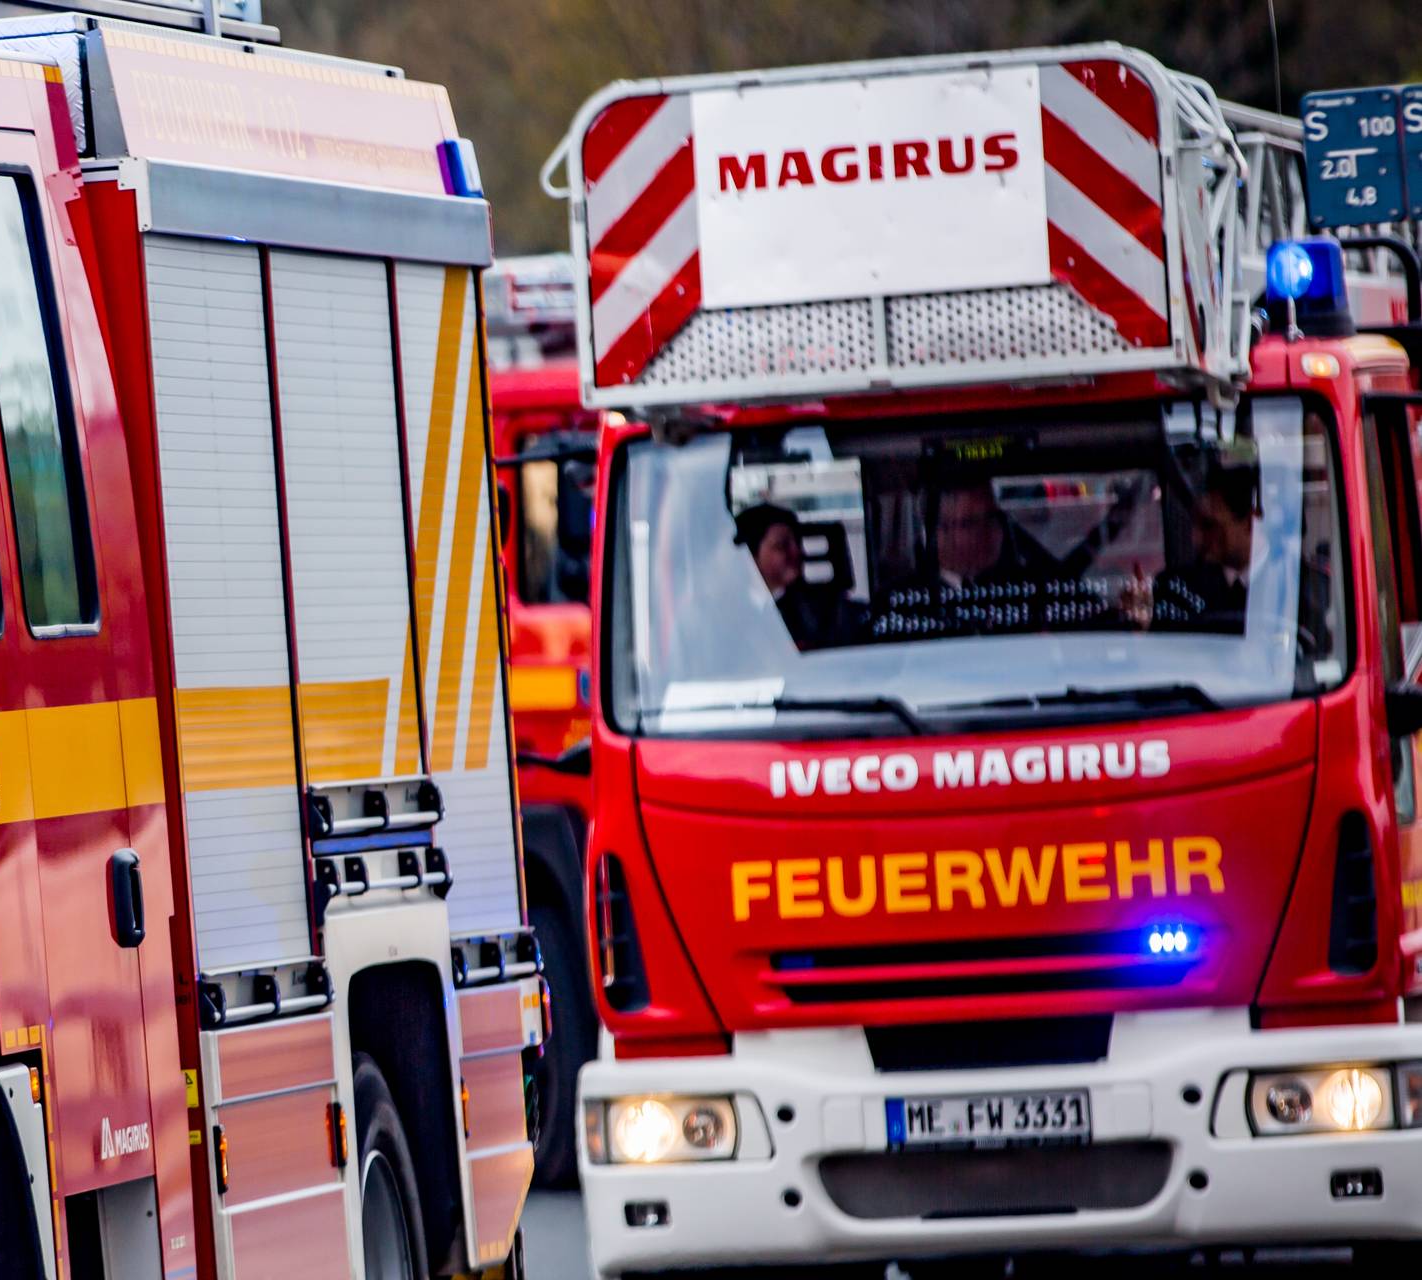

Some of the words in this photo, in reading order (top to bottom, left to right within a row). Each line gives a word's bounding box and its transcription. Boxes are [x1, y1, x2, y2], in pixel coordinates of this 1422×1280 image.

[1305, 111, 1329, 142] S
[1359, 115, 1396, 138] 100
[718, 131, 1019, 192] MAGIRUS
[770, 753, 919, 798] IVECO
[933, 739, 1170, 789] MAGIRUS
[731, 836, 1226, 922] FEUERWEHR
[967, 1100, 1004, 1130] FW
[1014, 1098, 1083, 1129] 3331
[115, 1122, 149, 1156] MAGIRUS
